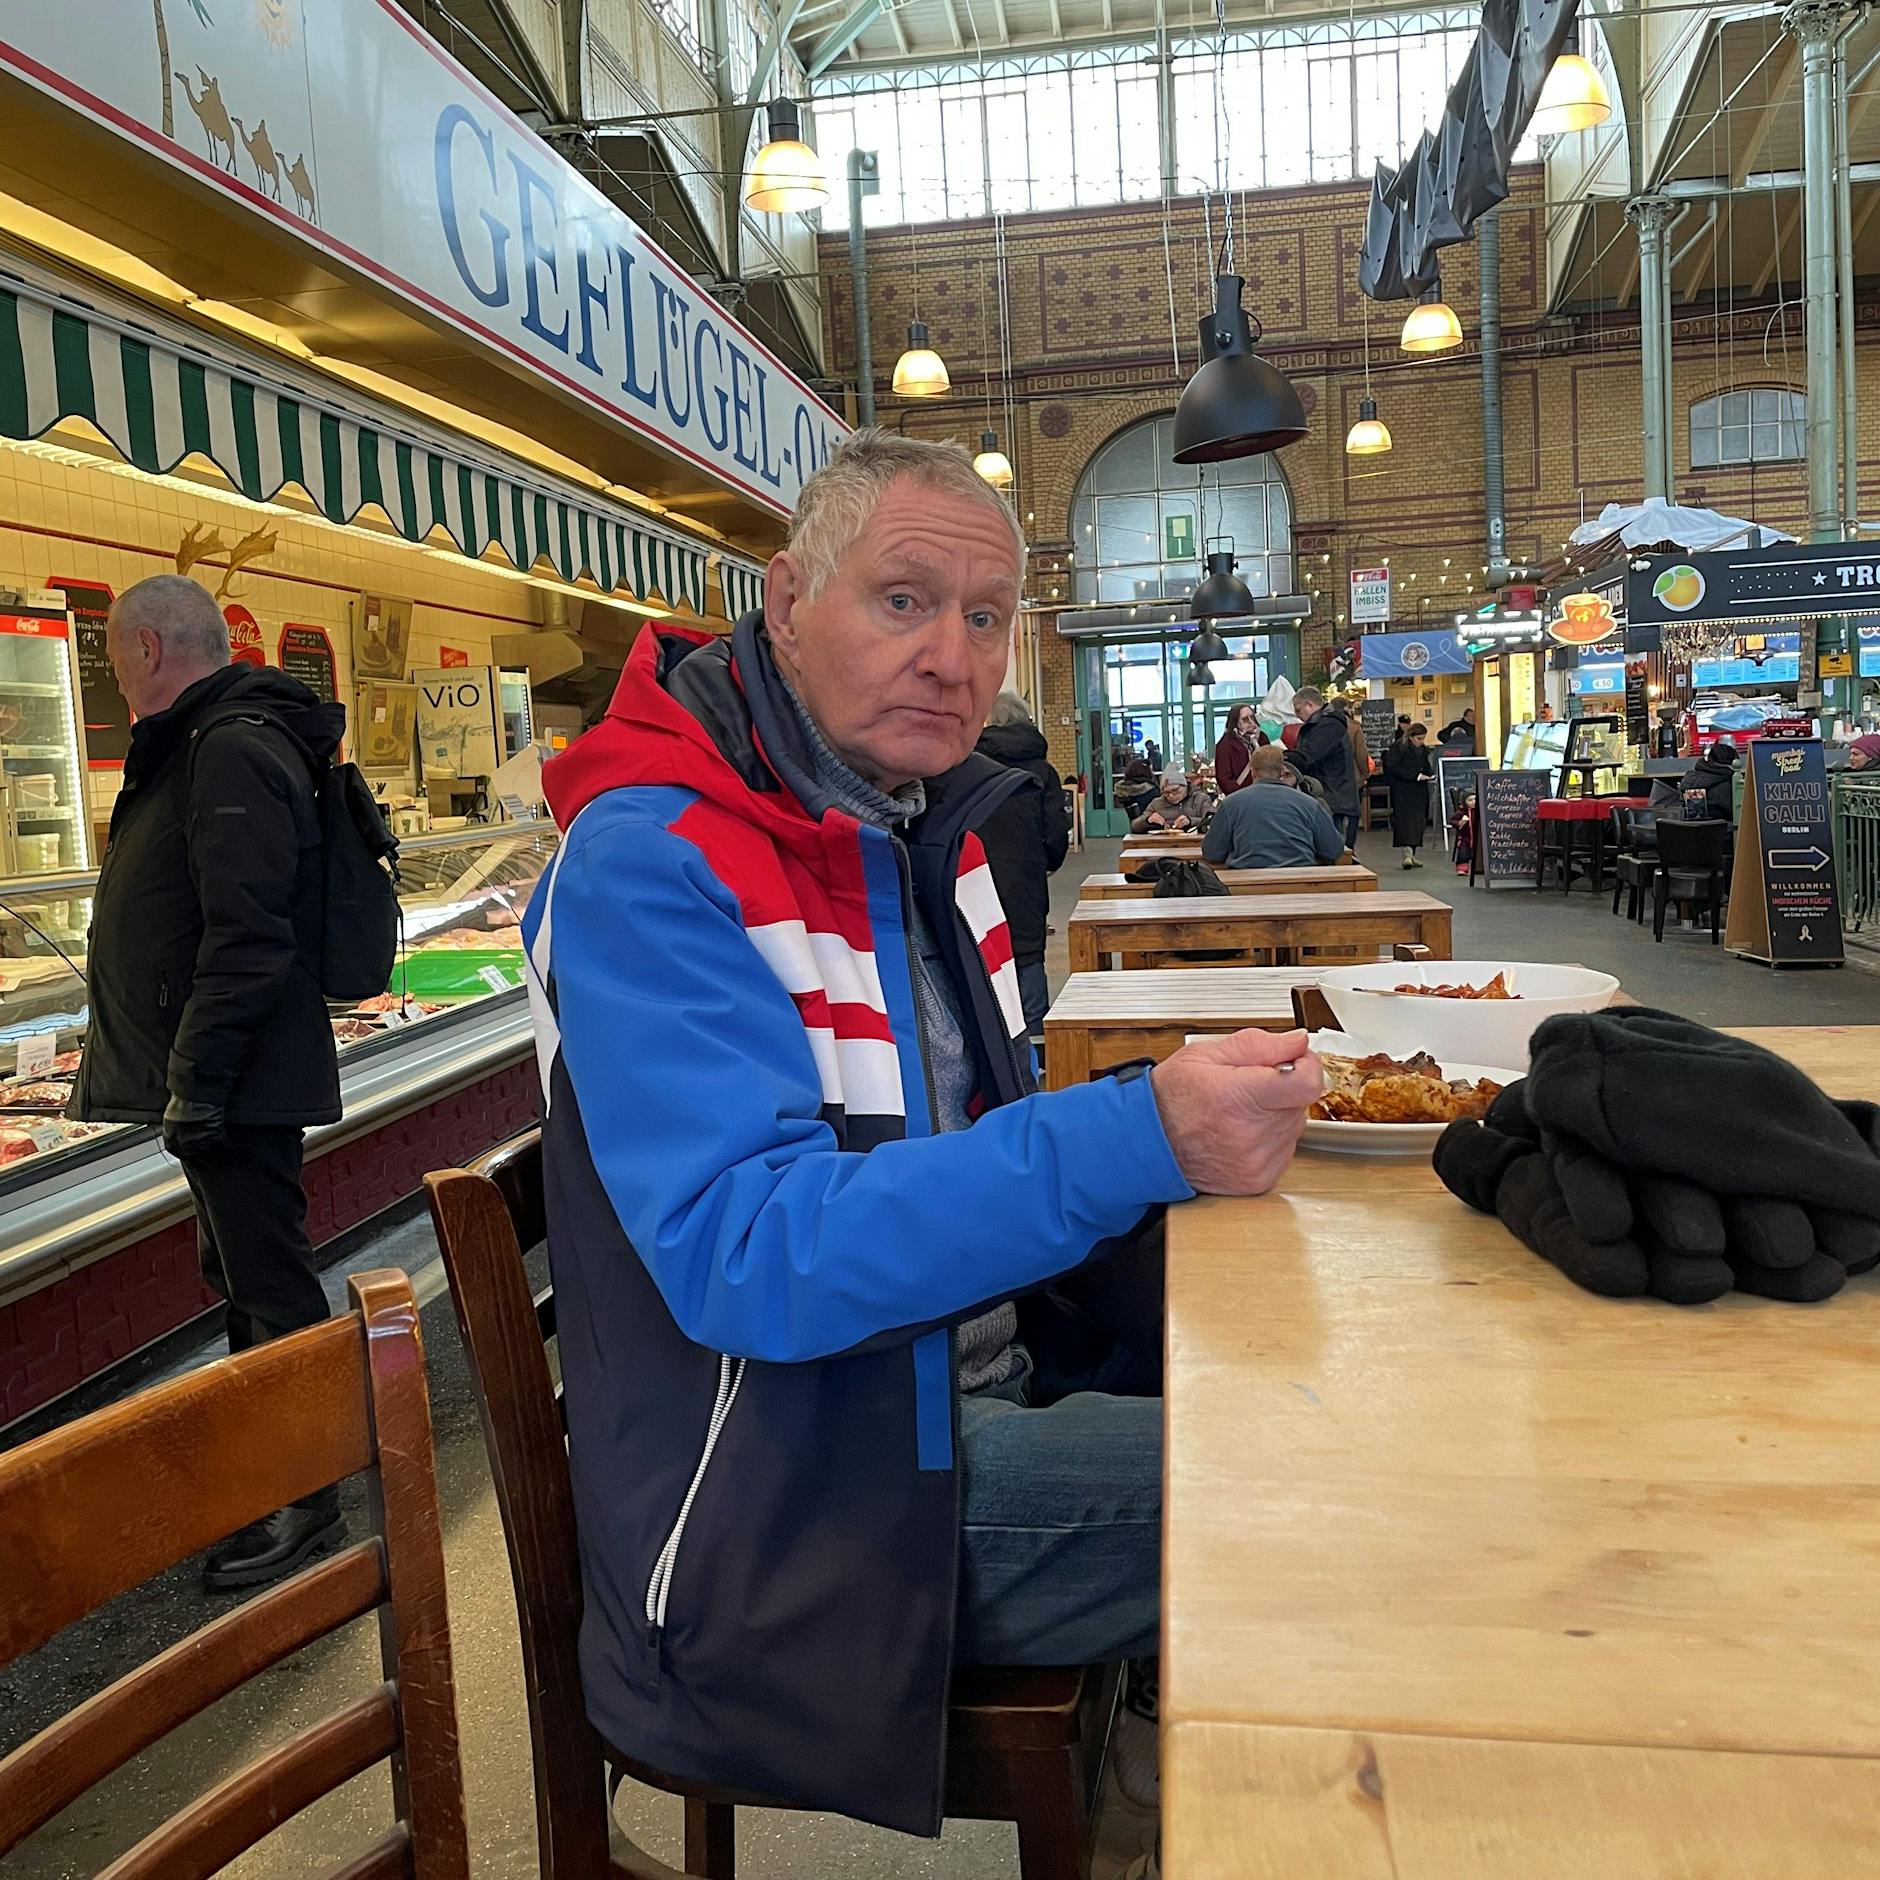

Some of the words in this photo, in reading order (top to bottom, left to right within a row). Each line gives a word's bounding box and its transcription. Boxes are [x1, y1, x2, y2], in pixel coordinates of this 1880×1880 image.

[1836, 565, 1880, 588] TR
[1355, 596, 1386, 606] IMBISS
[1594, 680, 1612, 688] 4.50
[1764, 783, 1821, 801] KHAU
[1764, 805, 1826, 823] GALLI
